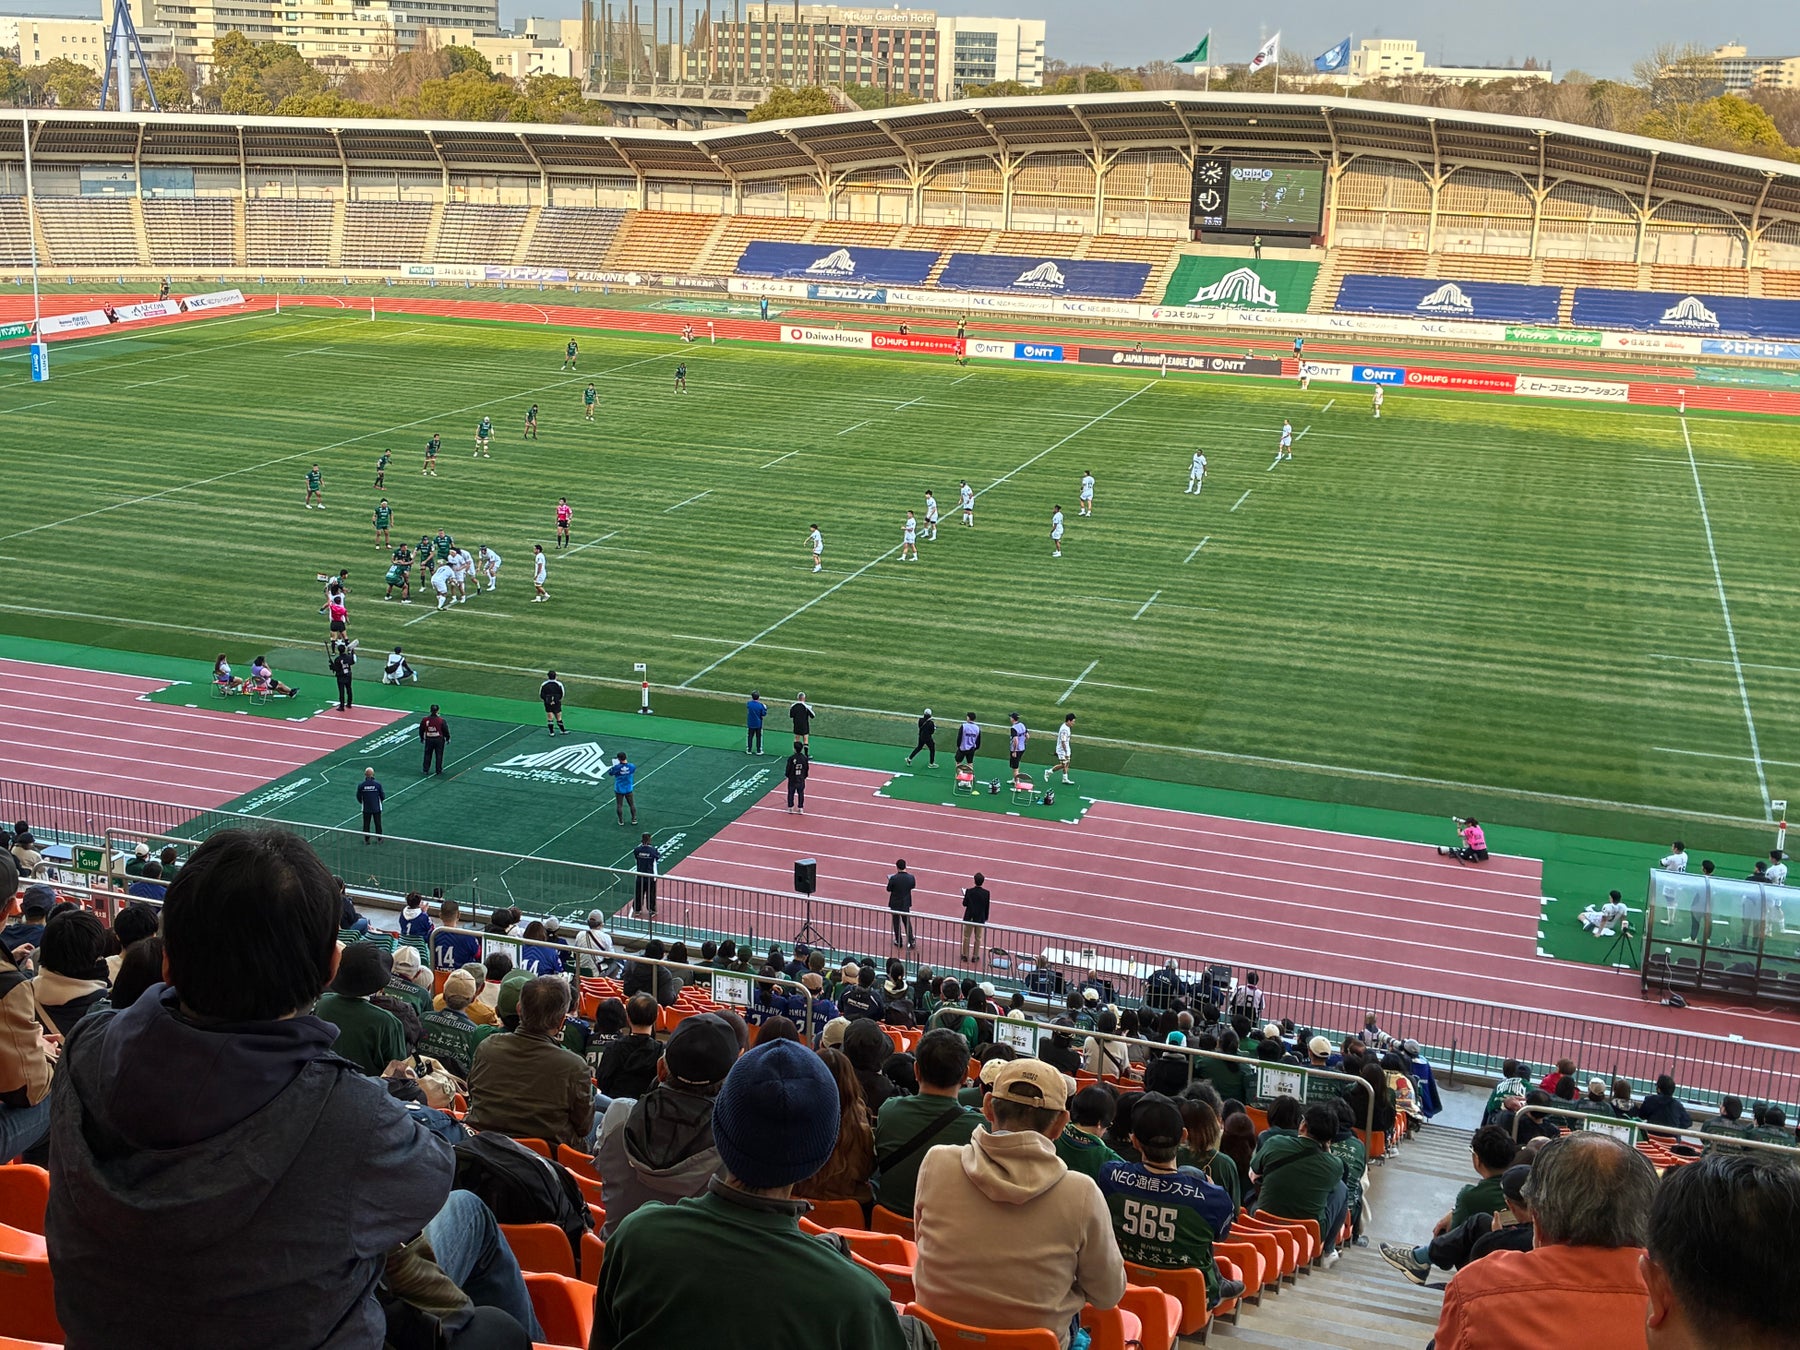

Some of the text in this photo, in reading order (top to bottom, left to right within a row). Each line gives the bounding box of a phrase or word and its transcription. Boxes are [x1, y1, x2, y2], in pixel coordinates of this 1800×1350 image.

[876, 12, 908, 22] Garden
[911, 14, 935, 23] Hotel
[576, 271, 625, 283] PLUSONE
[892, 292, 914, 301] NEC
[190, 298, 207, 308] NEC
[973, 298, 996, 306] NEC
[1063, 303, 1086, 312] NEC
[1165, 310, 1215, 320] コスモグループ
[1239, 313, 1263, 322] NEC
[1330, 318, 1354, 328] NEC
[1421, 324, 1446, 333] NEC
[887, 338, 908, 347] MUFG
[986, 345, 1004, 354] NTT
[1034, 348, 1054, 357] NTT
[1123, 354, 1143, 363] JAPAN
[1143, 355, 1164, 365] RUGBY
[1164, 356, 1188, 367] LEAGUE
[1224, 362, 1247, 371] NTT
[1320, 368, 1341, 376] NTT
[1374, 371, 1396, 381] NTT
[1423, 374, 1449, 384] MUFG
[406, 922, 412, 936] 1
[435, 945, 455, 968] 14
[599, 1033, 619, 1041] NEC
[1110, 1168, 1206, 1201] NEC通信システム
[1122, 1199, 1178, 1243] 565
